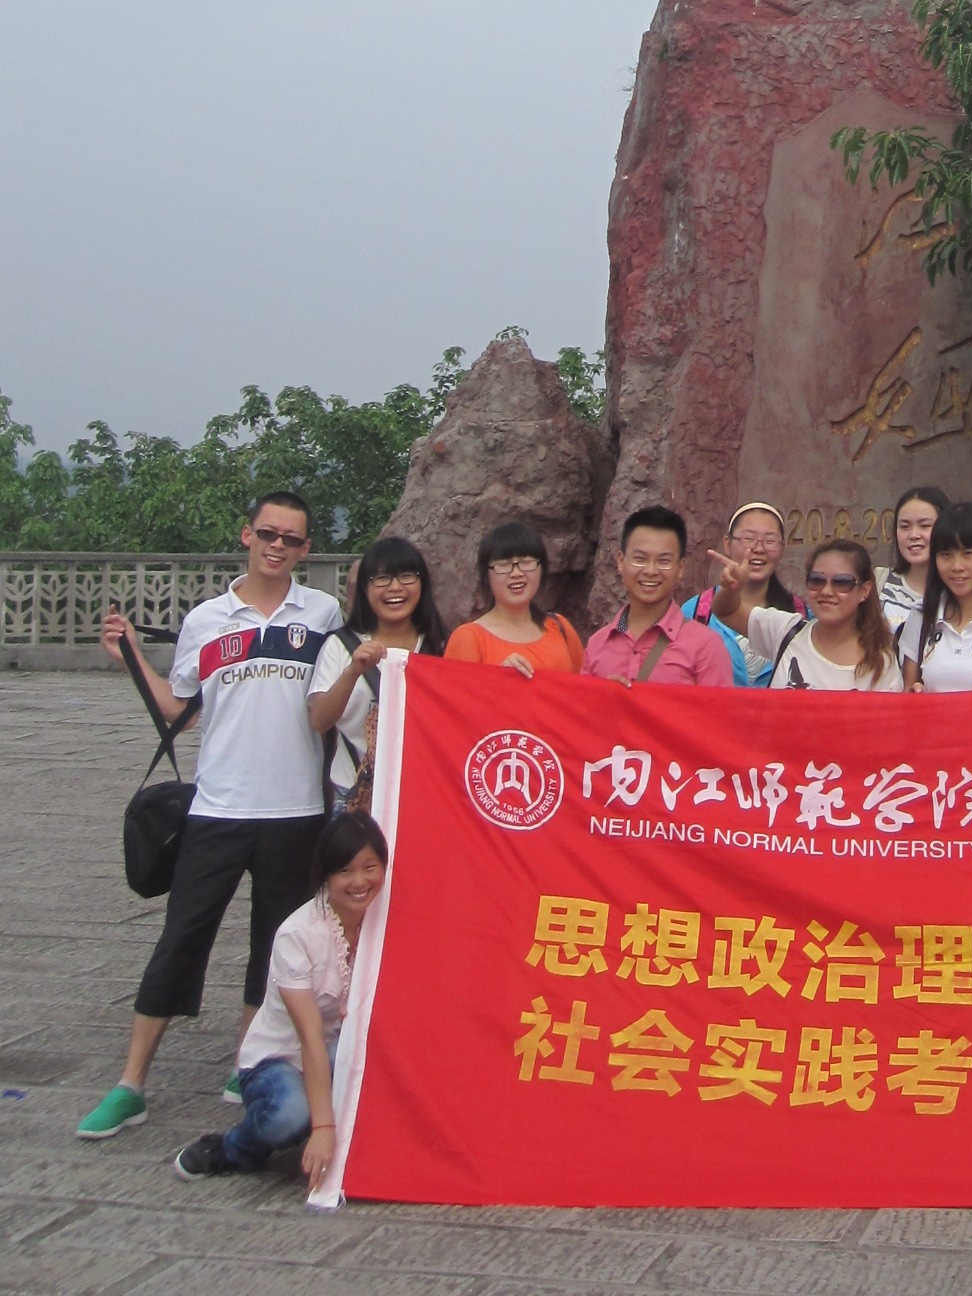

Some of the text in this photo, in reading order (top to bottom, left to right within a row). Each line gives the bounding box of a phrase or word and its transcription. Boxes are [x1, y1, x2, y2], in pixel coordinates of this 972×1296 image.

[220, 635, 242, 659] 10
[222, 664, 307, 684] CHAMPION
[471, 767, 557, 824] NEIJIANG NORMAL UNIVERSITY
[502, 802, 525, 816] 1956
[590, 816, 705, 843] NEIJIANG
[713, 828, 824, 856] NORMAL
